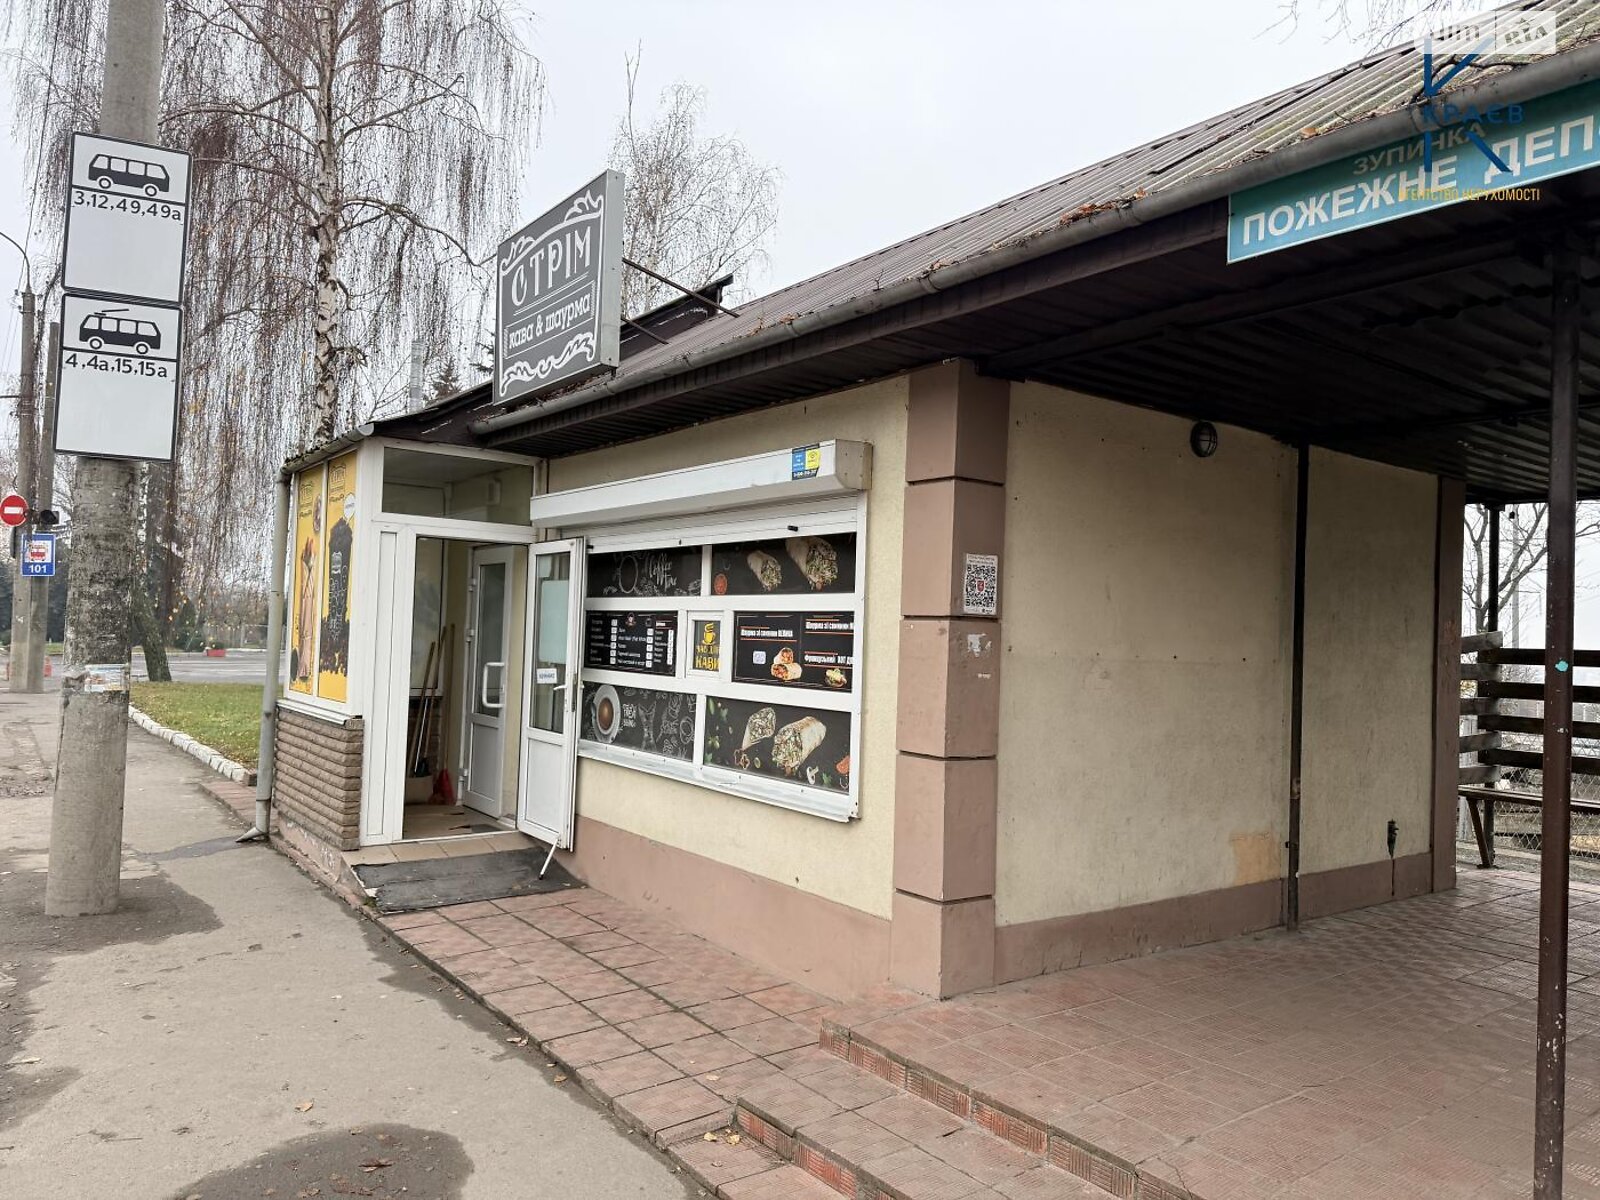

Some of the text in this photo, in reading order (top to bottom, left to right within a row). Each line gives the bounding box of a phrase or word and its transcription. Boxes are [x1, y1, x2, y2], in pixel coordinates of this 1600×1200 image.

[1353, 122, 1486, 176] ЗУПИНКА
[1243, 114, 1600, 245] ПОЖЕЖНЕ ДЕП
[512, 226, 591, 306] СТРІМ
[509, 292, 591, 349] кава & шаурма
[28, 564, 47, 573] 101
